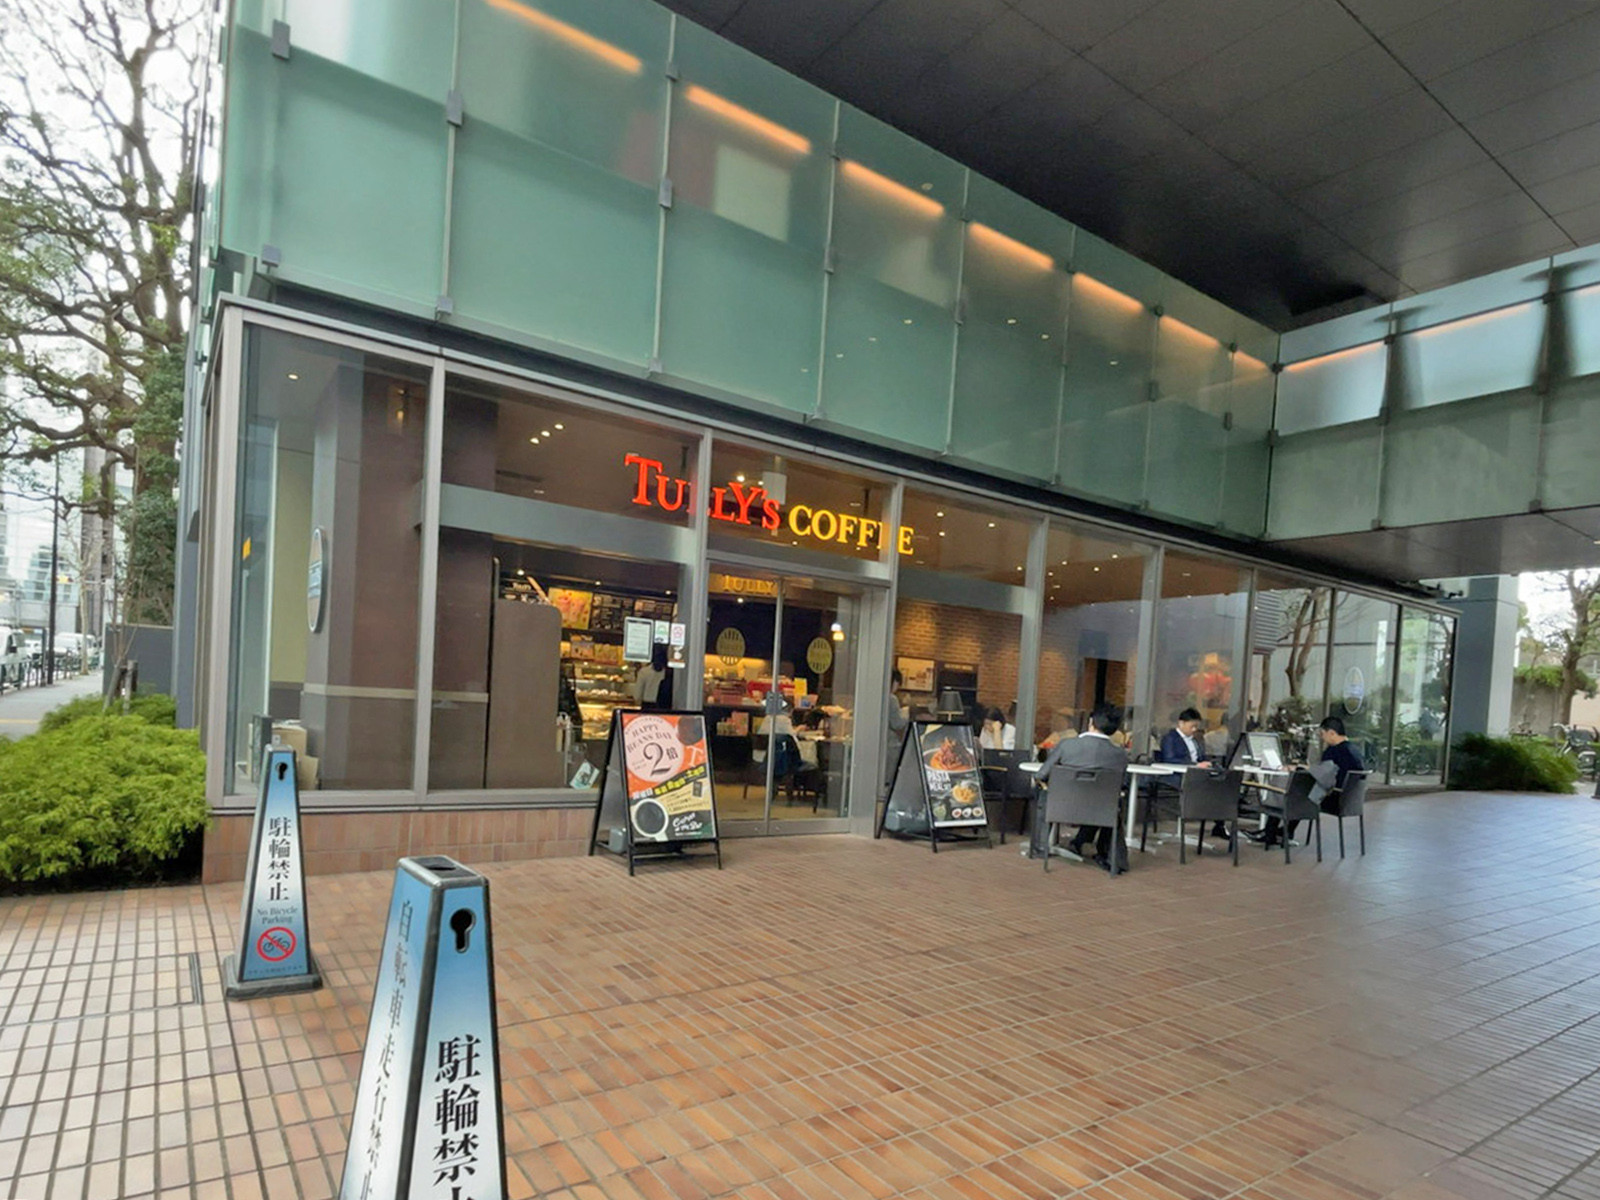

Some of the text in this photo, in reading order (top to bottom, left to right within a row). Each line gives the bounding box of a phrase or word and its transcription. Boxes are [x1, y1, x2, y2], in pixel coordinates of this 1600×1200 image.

[624, 453, 782, 531] TULY'S
[267, 817, 292, 901] 駐輪禁止
[262, 916, 293, 925] Parking
